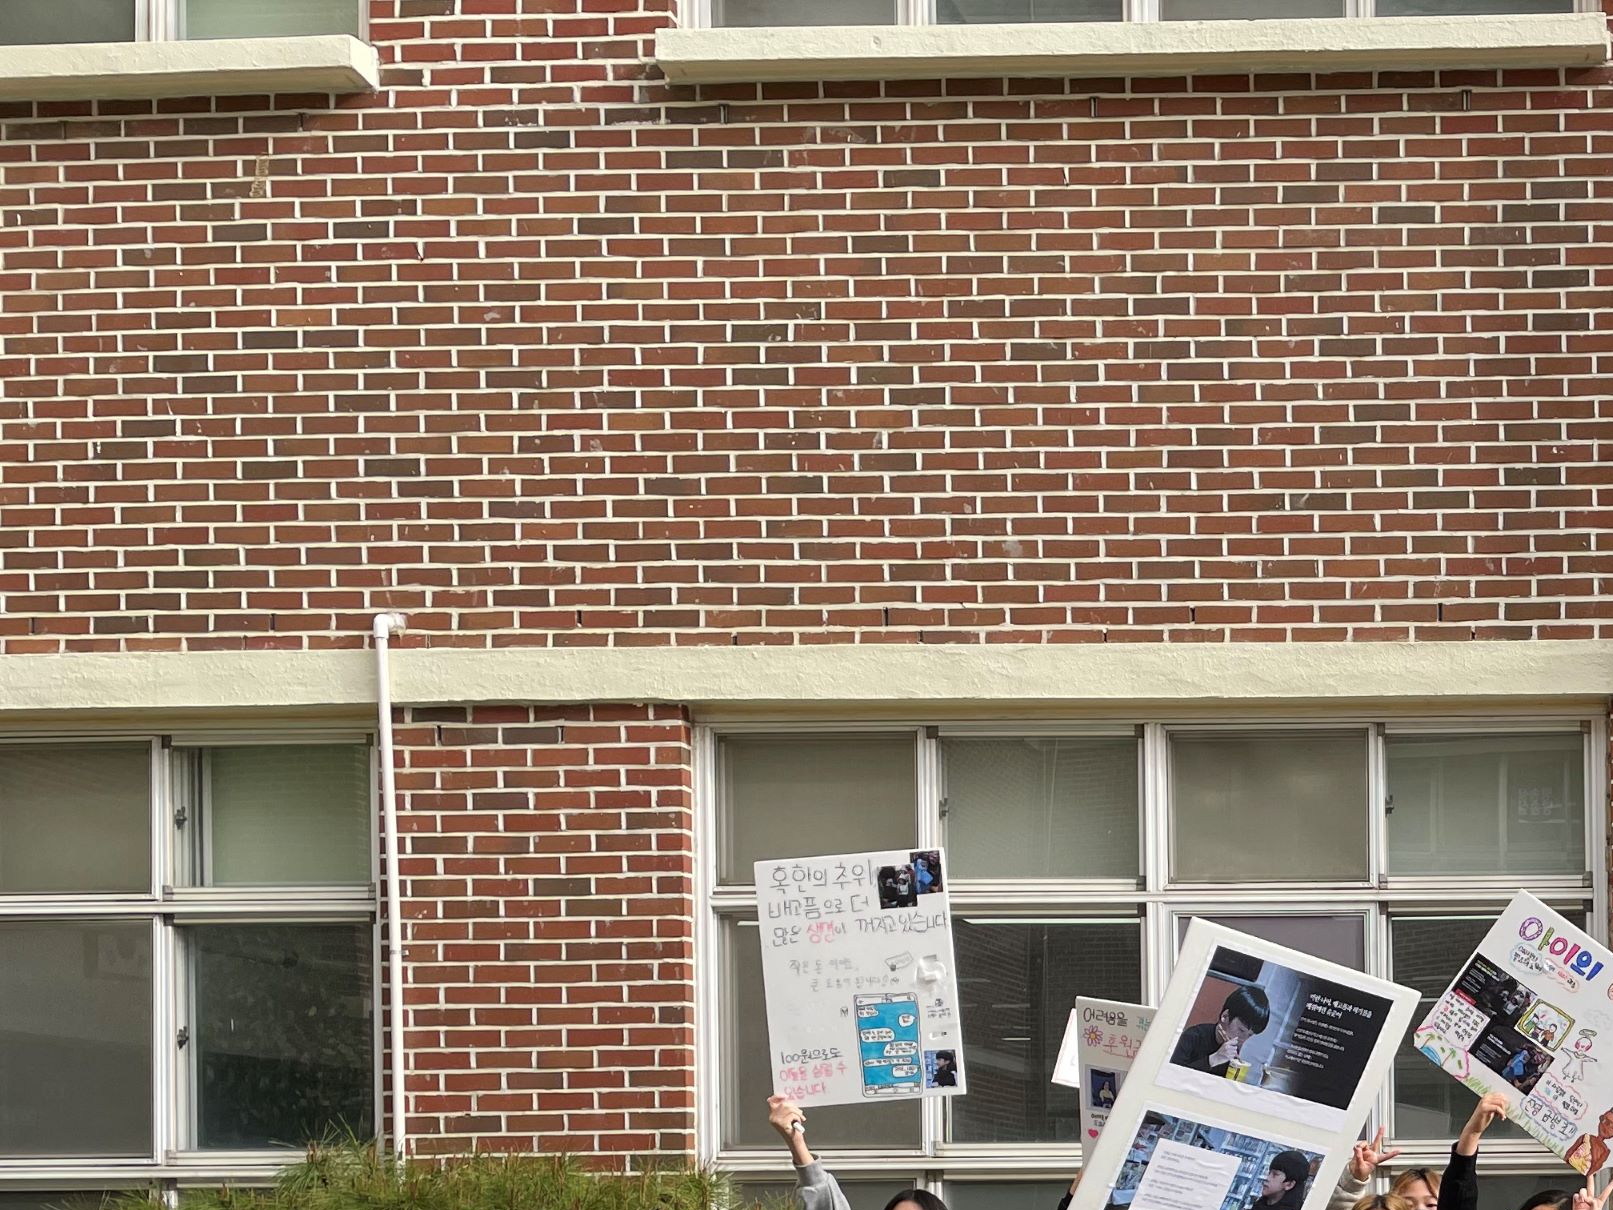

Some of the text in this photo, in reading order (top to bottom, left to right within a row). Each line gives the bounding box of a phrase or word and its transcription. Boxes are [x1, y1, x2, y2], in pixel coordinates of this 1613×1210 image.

[769, 863, 828, 894] 혹한의
[768, 894, 869, 919] 배고픔으로 더
[772, 924, 802, 947] 많은
[855, 914, 898, 933] 꺼지고
[1518, 916, 1604, 982] 아이의
[1083, 1007, 1128, 1027] 어려움을
